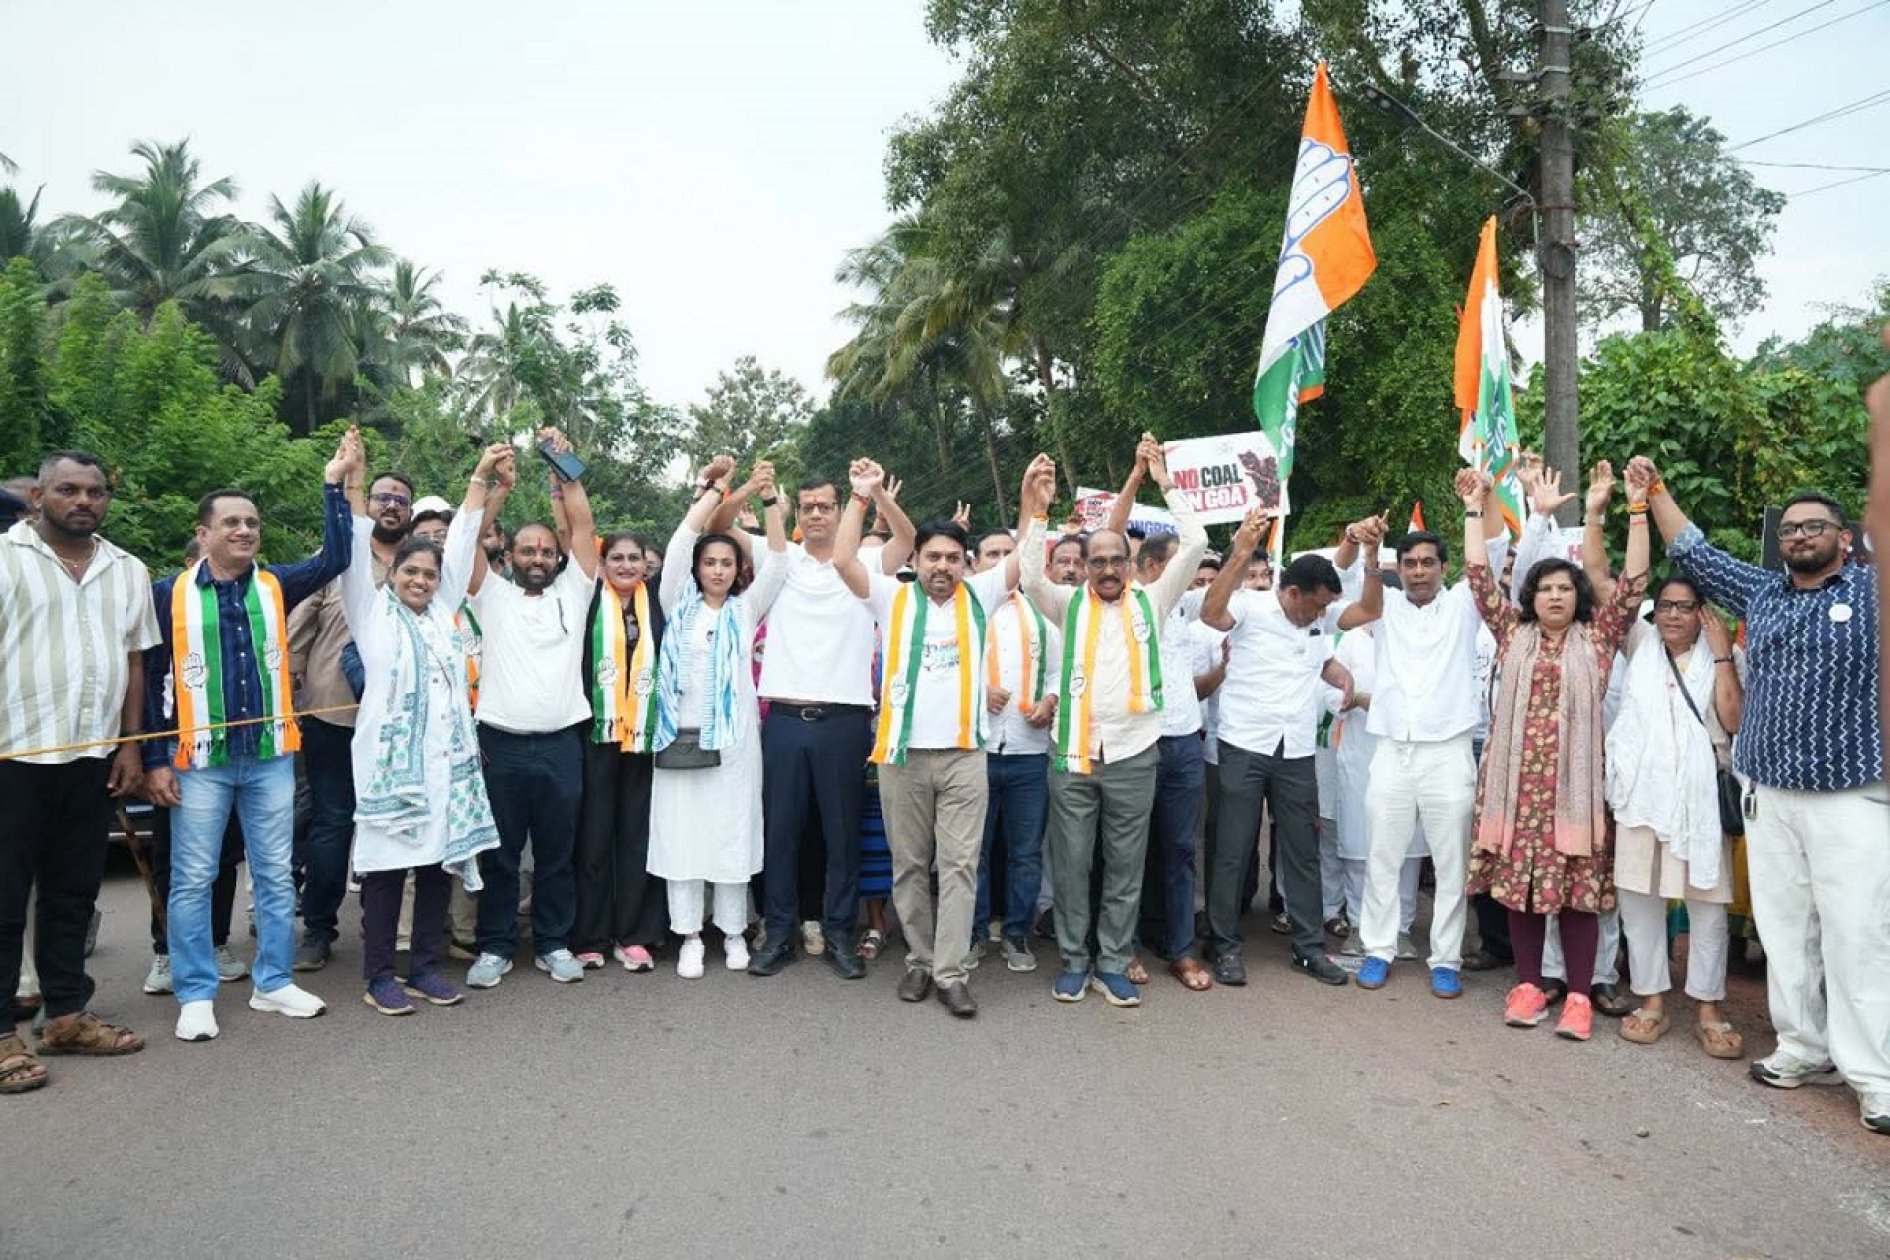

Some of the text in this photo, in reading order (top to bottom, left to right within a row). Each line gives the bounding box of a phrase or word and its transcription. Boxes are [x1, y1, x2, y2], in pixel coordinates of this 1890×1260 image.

[1173, 463, 1243, 490] NO COAL
[1205, 485, 1244, 508] GOA
